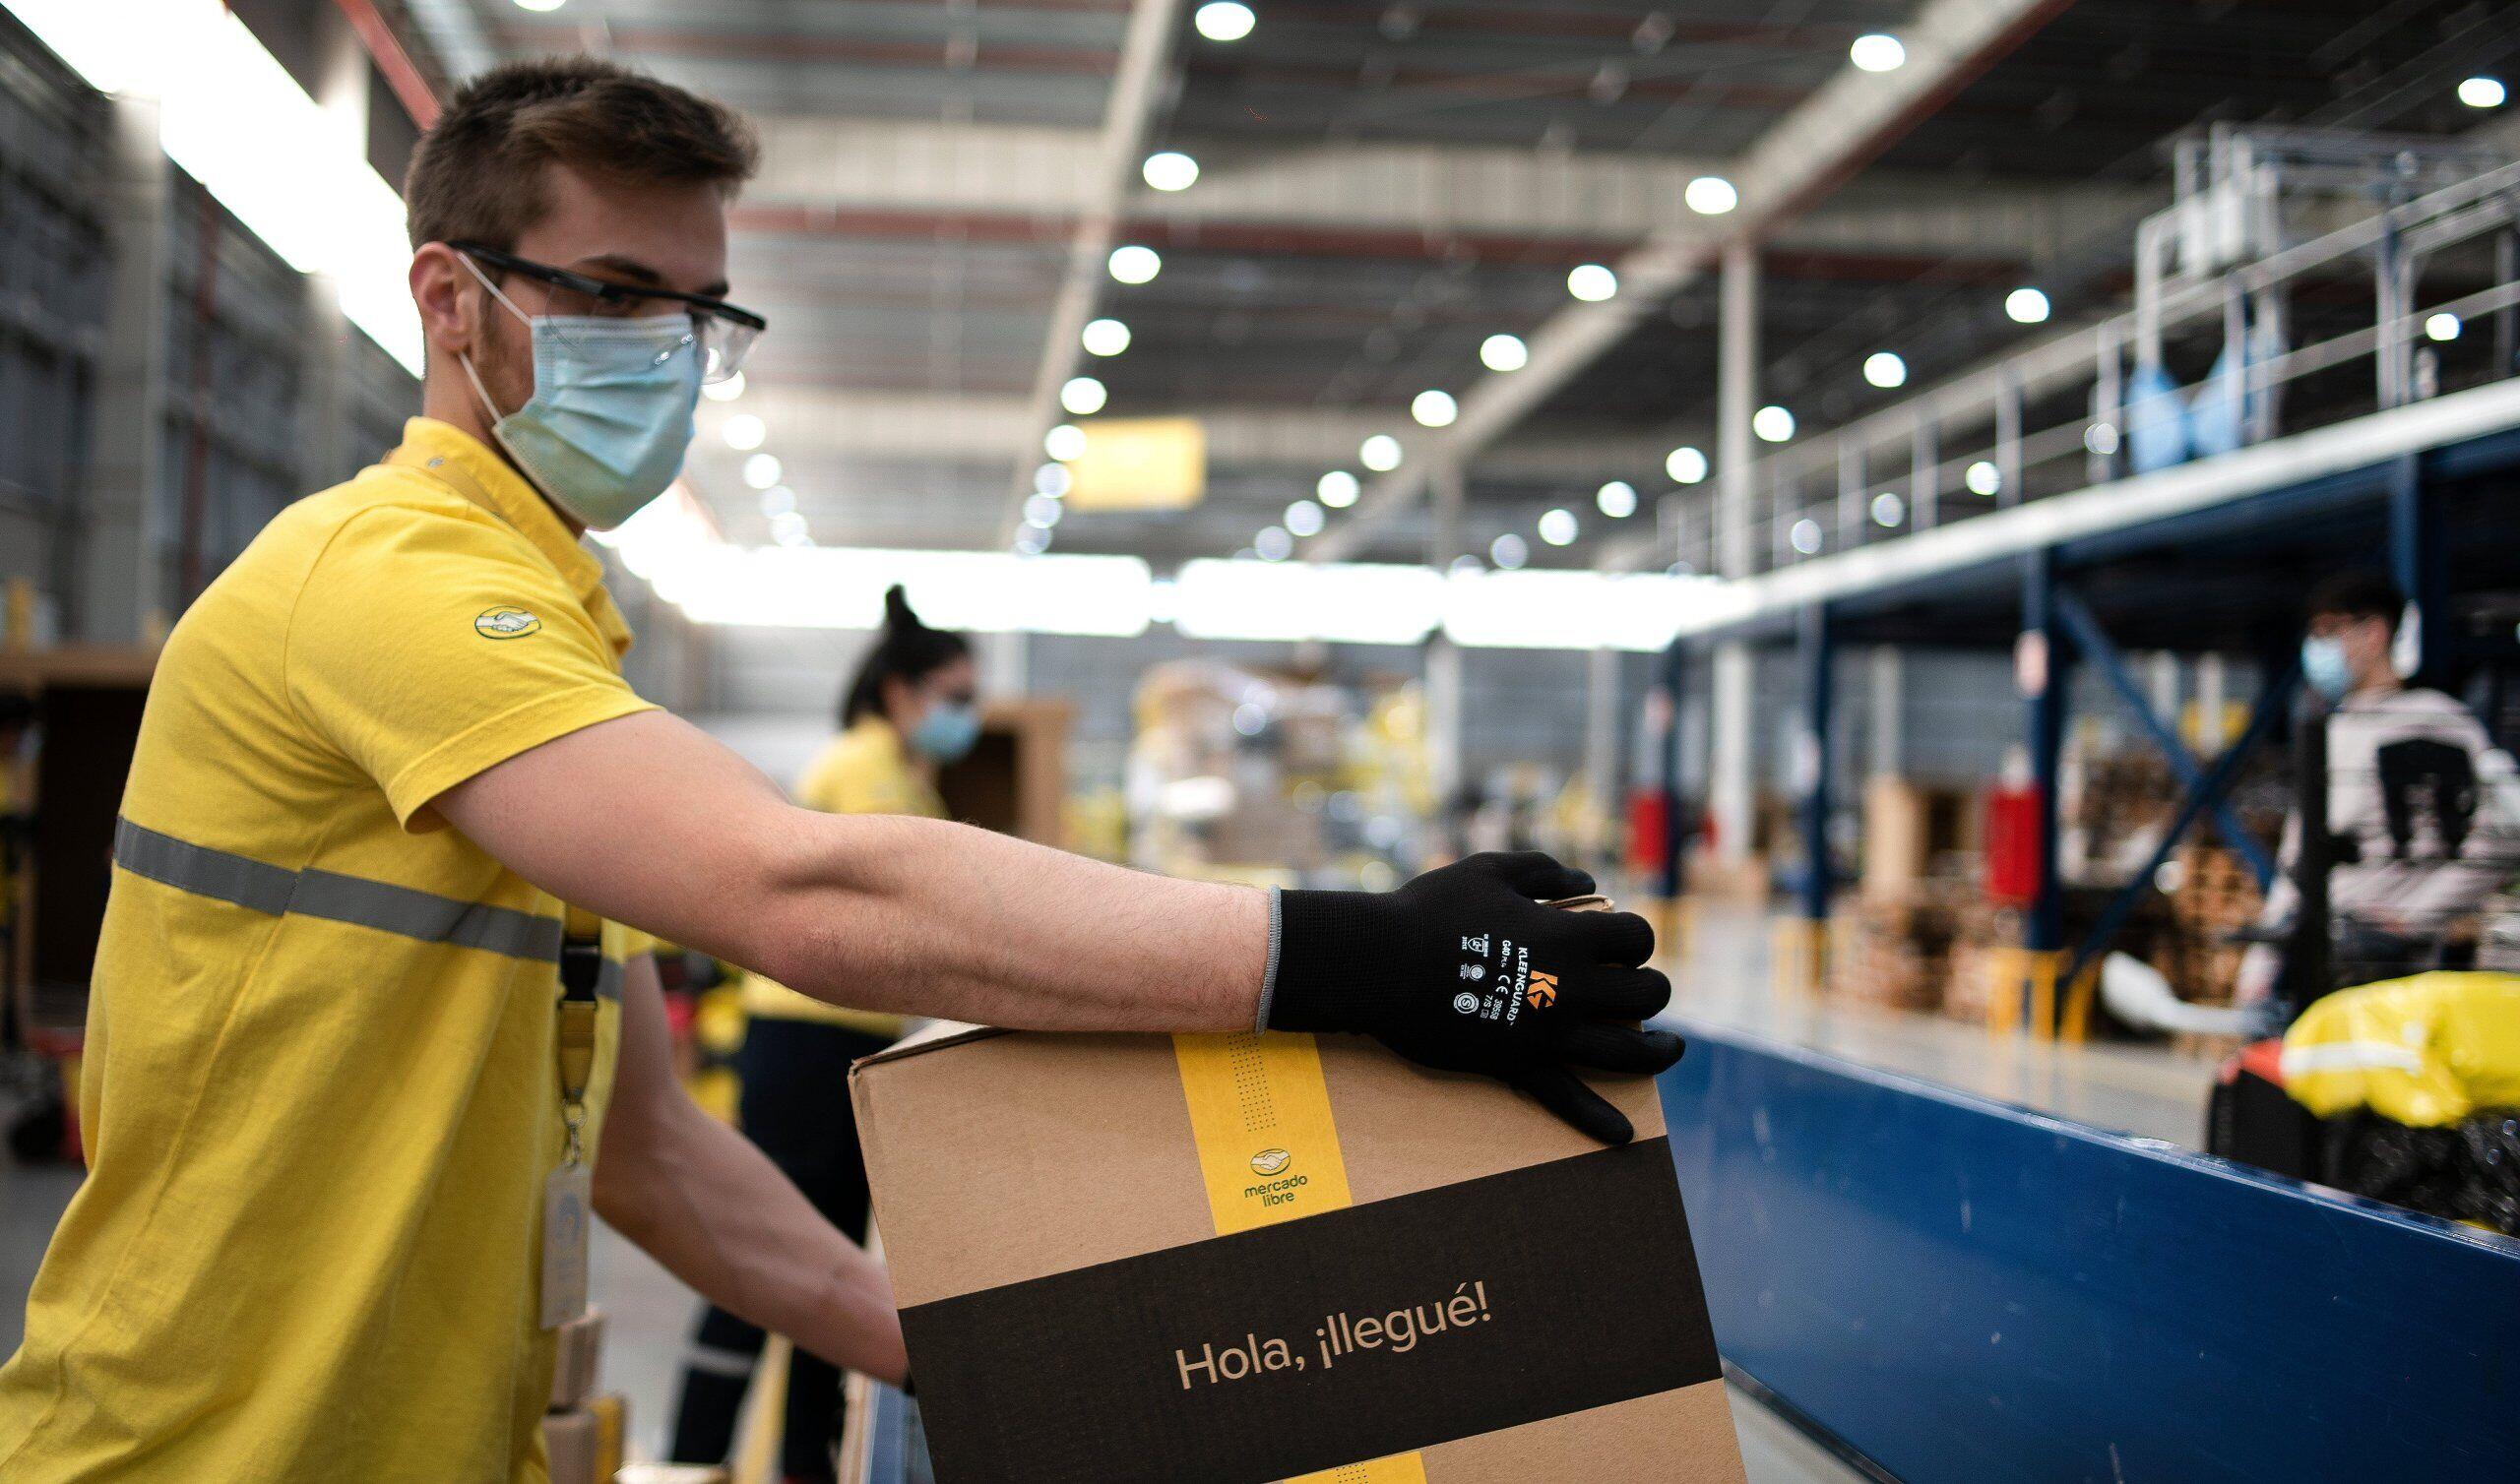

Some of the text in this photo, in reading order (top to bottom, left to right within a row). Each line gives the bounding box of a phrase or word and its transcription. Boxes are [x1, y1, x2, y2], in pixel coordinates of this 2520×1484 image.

[1501, 940, 1512, 957] G40
[1506, 947, 1529, 1021] KLEENGUARD
[1244, 1174, 1308, 1199] mercado
[1263, 1190, 1294, 1207] libre
[1175, 1280, 1492, 1391] Hola, ¡llegué!
